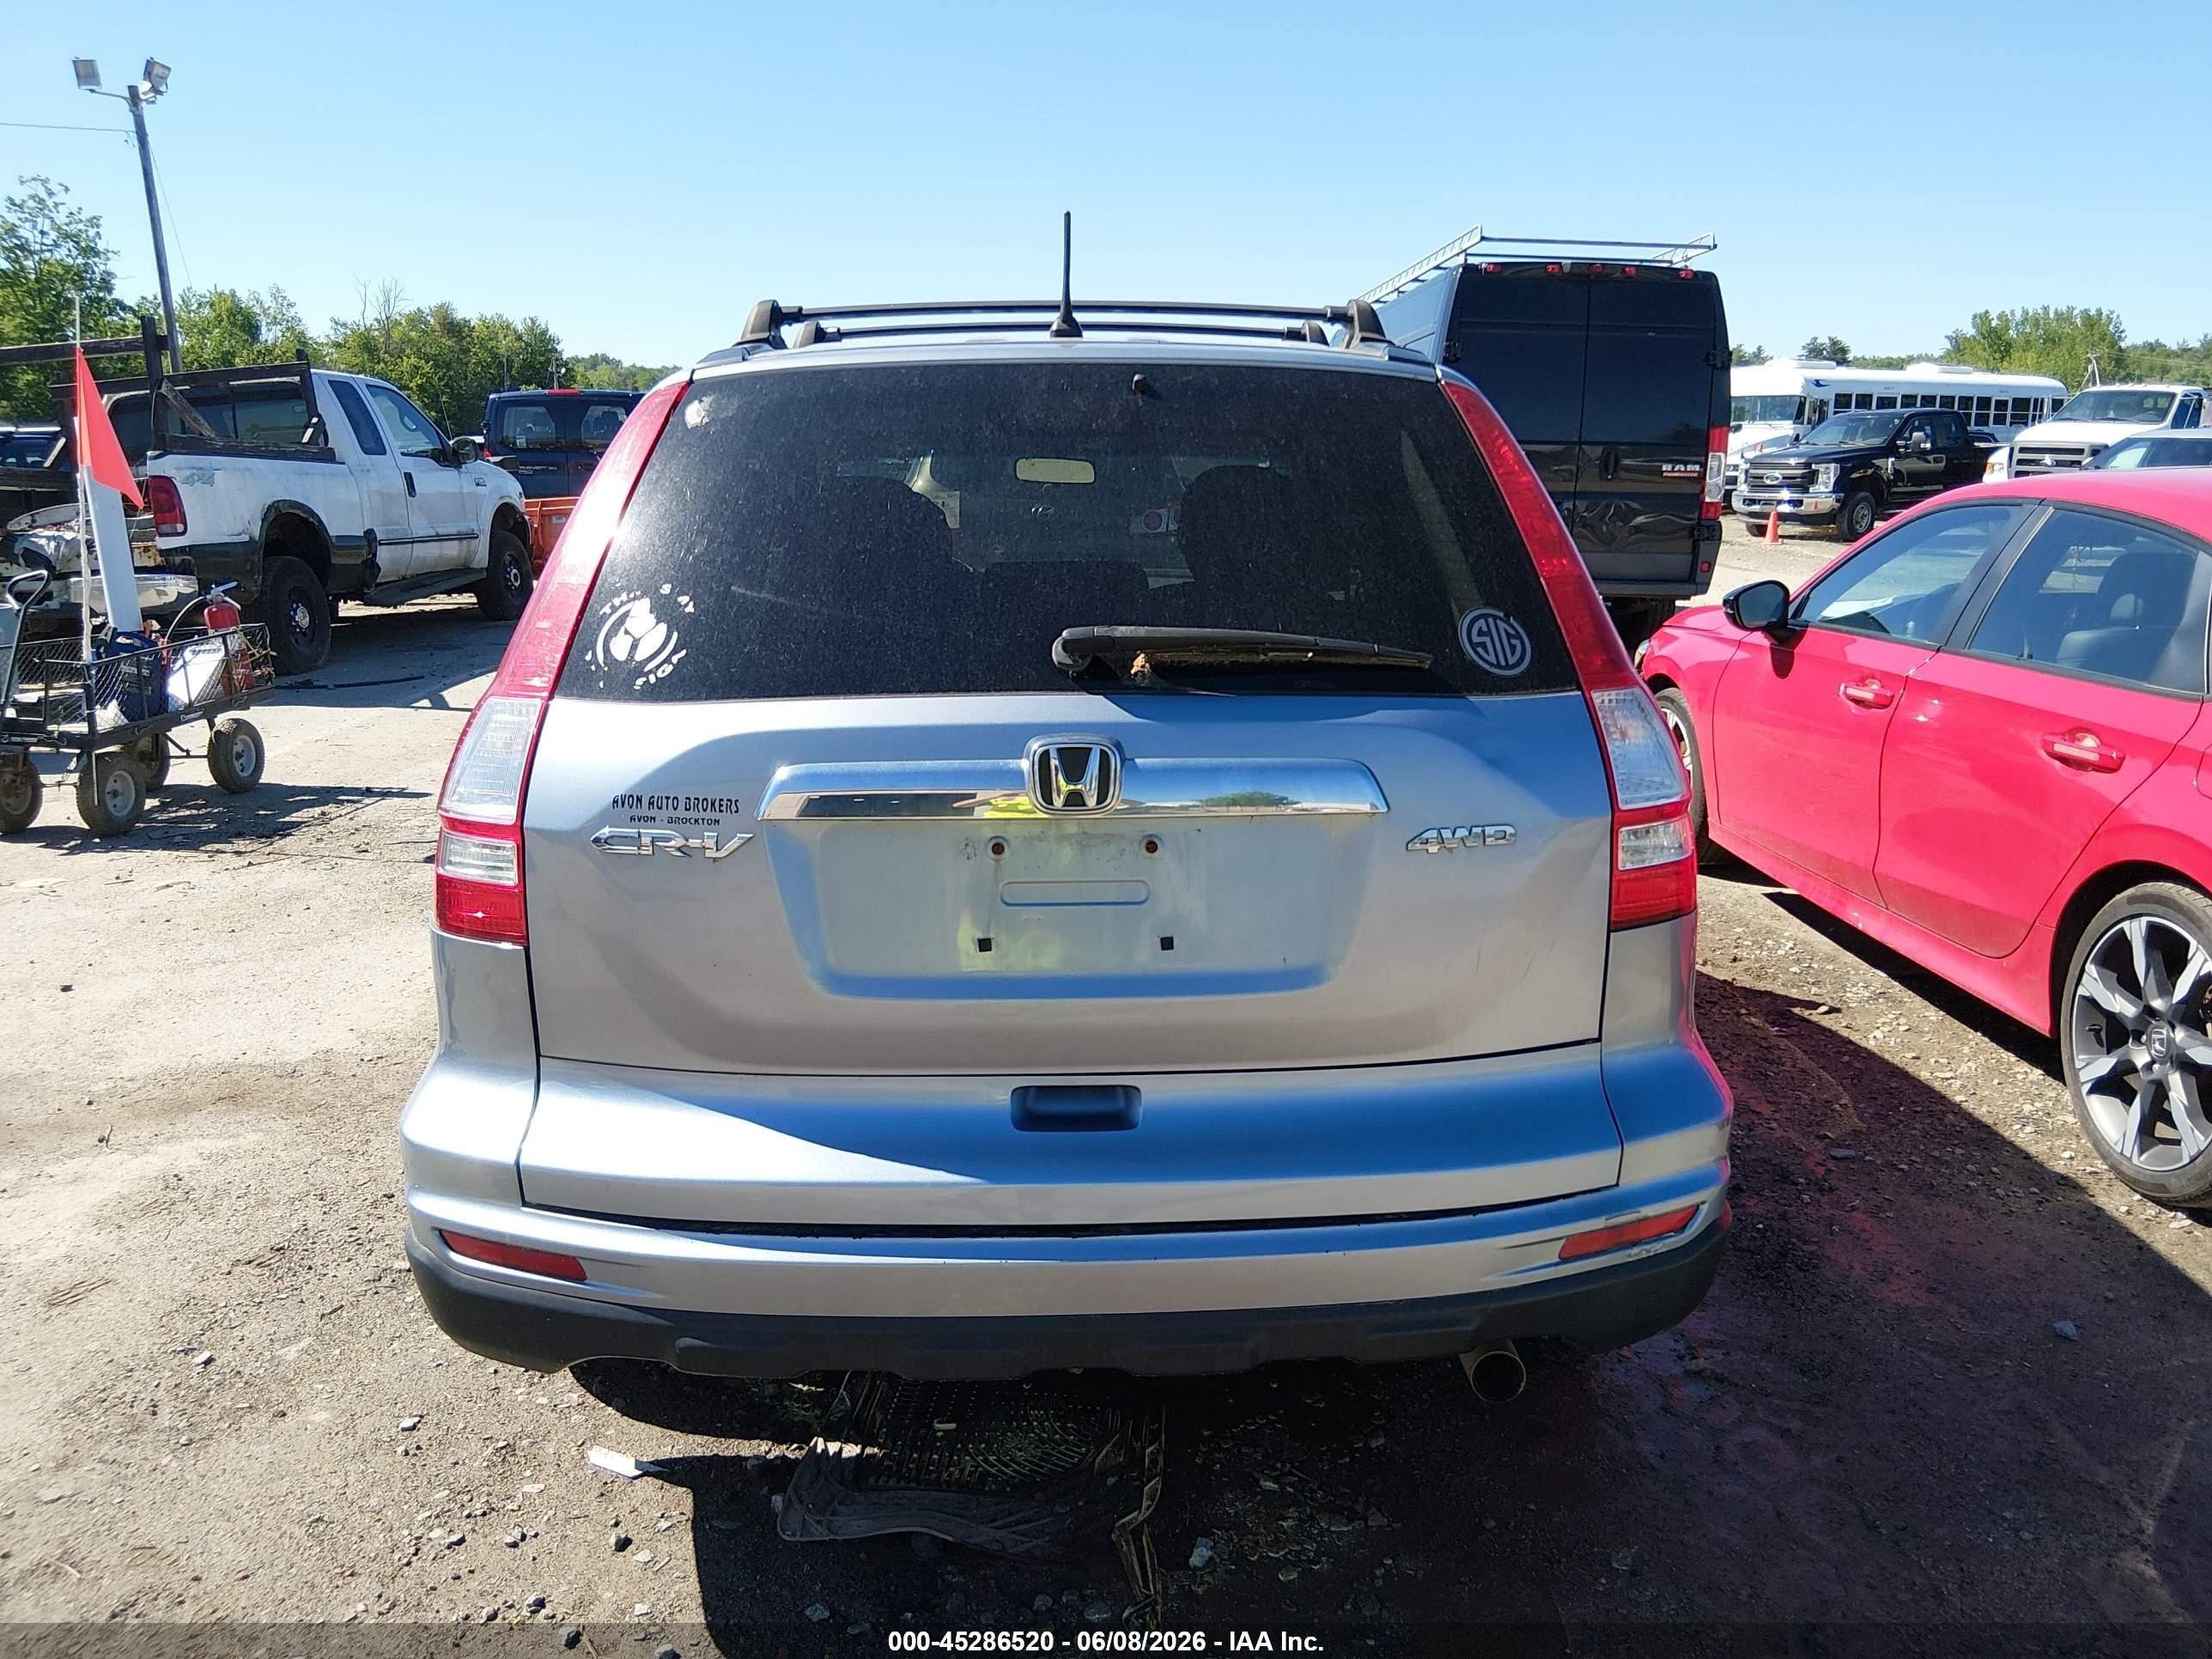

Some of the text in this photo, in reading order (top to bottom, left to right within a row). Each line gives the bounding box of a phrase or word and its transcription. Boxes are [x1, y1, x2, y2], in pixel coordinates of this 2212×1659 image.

[611, 793, 740, 814] AVON AUTO BROKERS
[629, 815, 656, 823] AVON
[666, 816, 720, 826] BROCKTON
[590, 827, 756, 860] CR-V
[1406, 824, 1517, 854] 4WD
